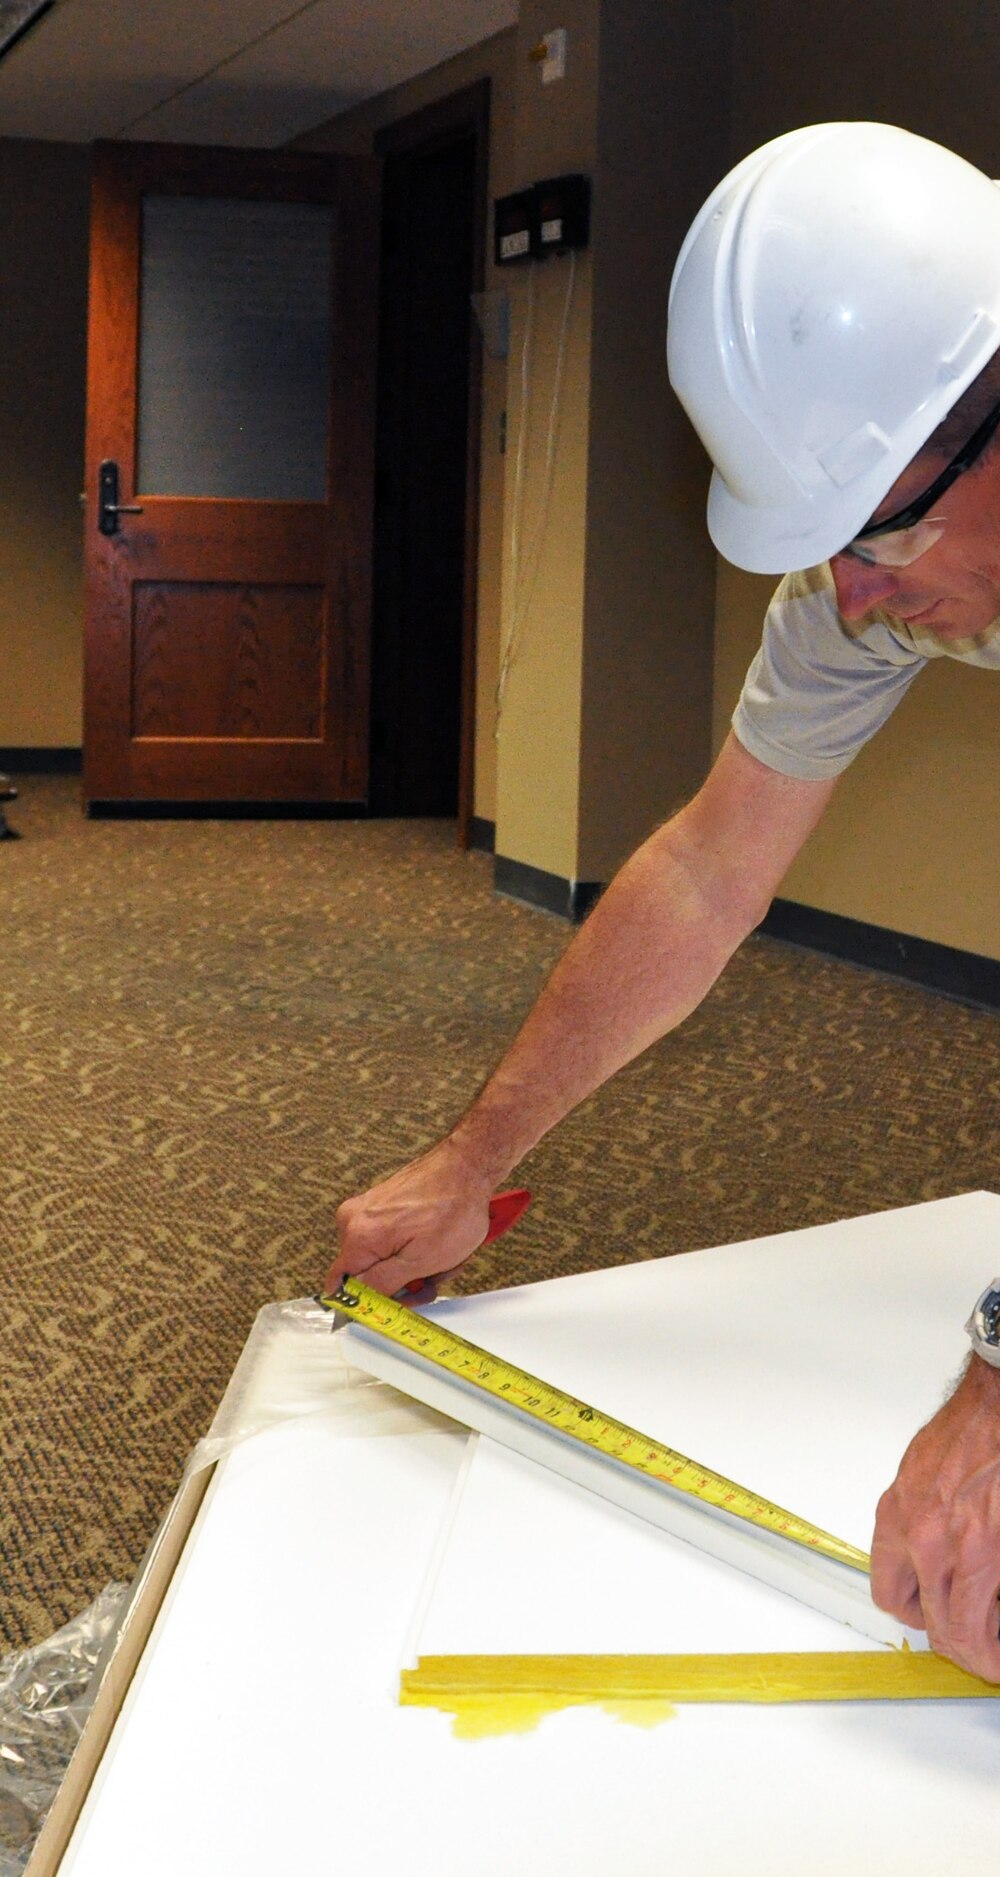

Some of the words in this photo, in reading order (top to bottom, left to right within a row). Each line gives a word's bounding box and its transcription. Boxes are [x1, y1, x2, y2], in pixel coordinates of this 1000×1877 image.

[381, 1317, 392, 1326] 3
[400, 1328, 411, 1336] 4
[418, 1338, 430, 1347] 5
[438, 1349, 449, 1357] 6
[458, 1360, 470, 1368] 7
[477, 1371, 490, 1380] 8
[498, 1383, 511, 1391] 9
[523, 1396, 541, 1407] 10
[544, 1407, 561, 1418] 11
[622, 1439, 632, 1449] 2
